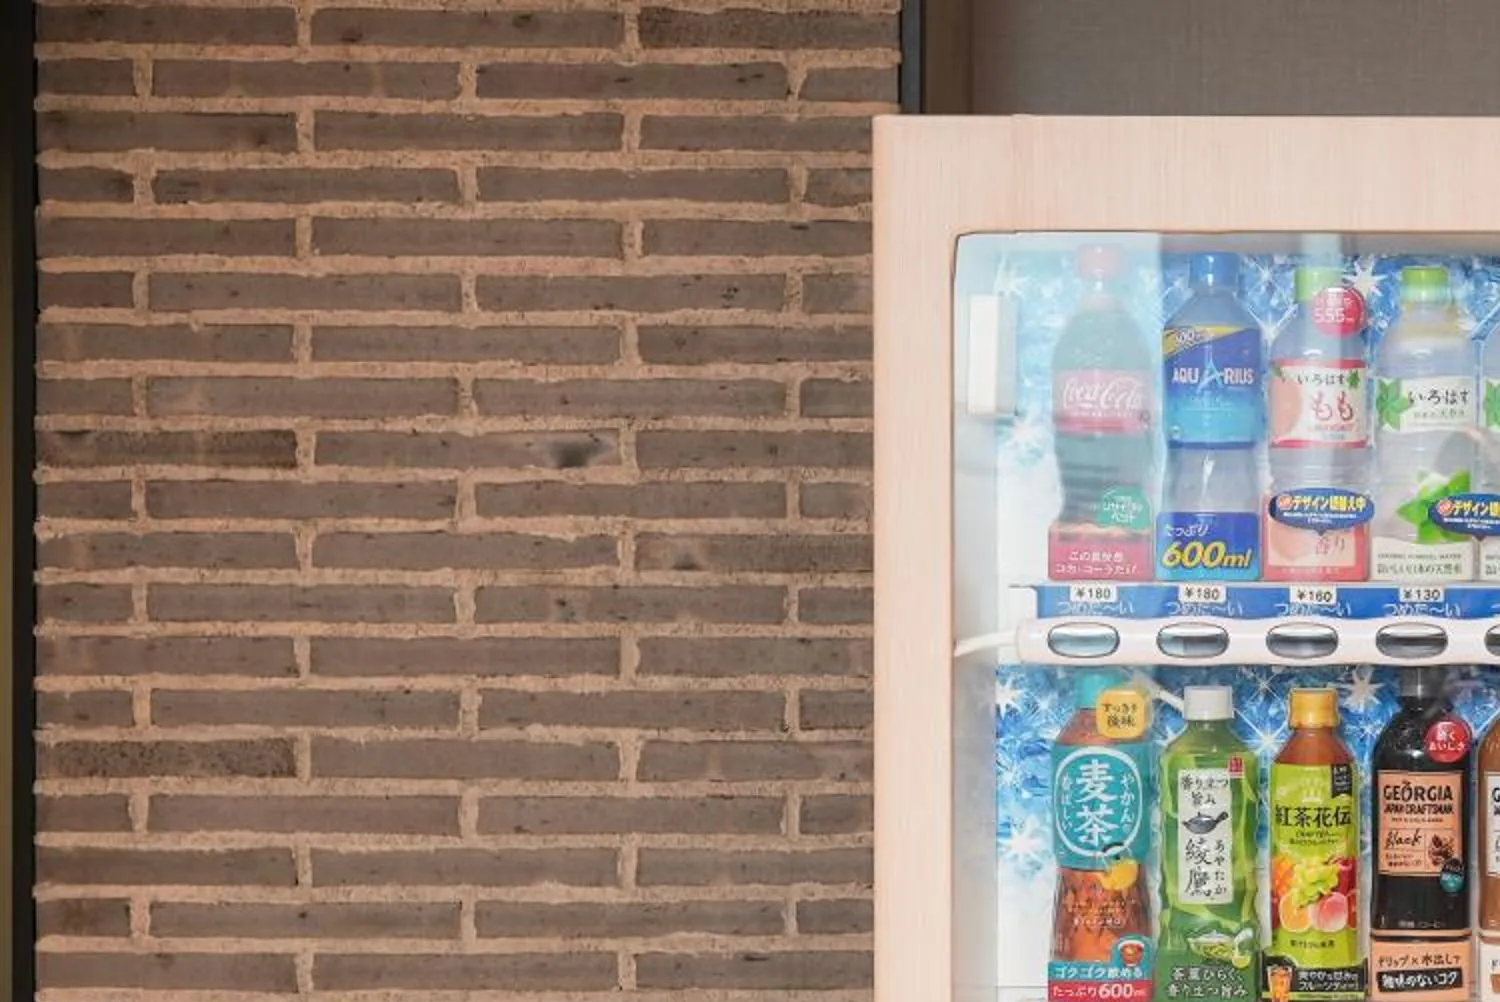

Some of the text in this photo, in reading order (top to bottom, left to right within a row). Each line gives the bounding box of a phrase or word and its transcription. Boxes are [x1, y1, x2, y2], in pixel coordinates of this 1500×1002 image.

[1172, 358, 1254, 393] AQUARIUS
[1311, 392, 1354, 421] もも
[1408, 390, 1471, 406] いろはす
[1162, 541, 1253, 570] 600ml
[1076, 587, 1111, 599] ¥180
[1184, 587, 1220, 601] ¥180
[1297, 590, 1333, 603] ¥160
[1403, 589, 1441, 601] ¥130
[1181, 774, 1230, 790] 香り立つ
[1383, 781, 1453, 803] GEORGIA
[1074, 758, 1120, 847] 麦茶
[1275, 804, 1352, 828] 紅茶花伝
[1385, 828, 1422, 849] Black
[1185, 838, 1213, 898] 綾鷹
[1214, 839, 1228, 896] あやたか
[1055, 966, 1144, 979] ゴクゴク飲める
